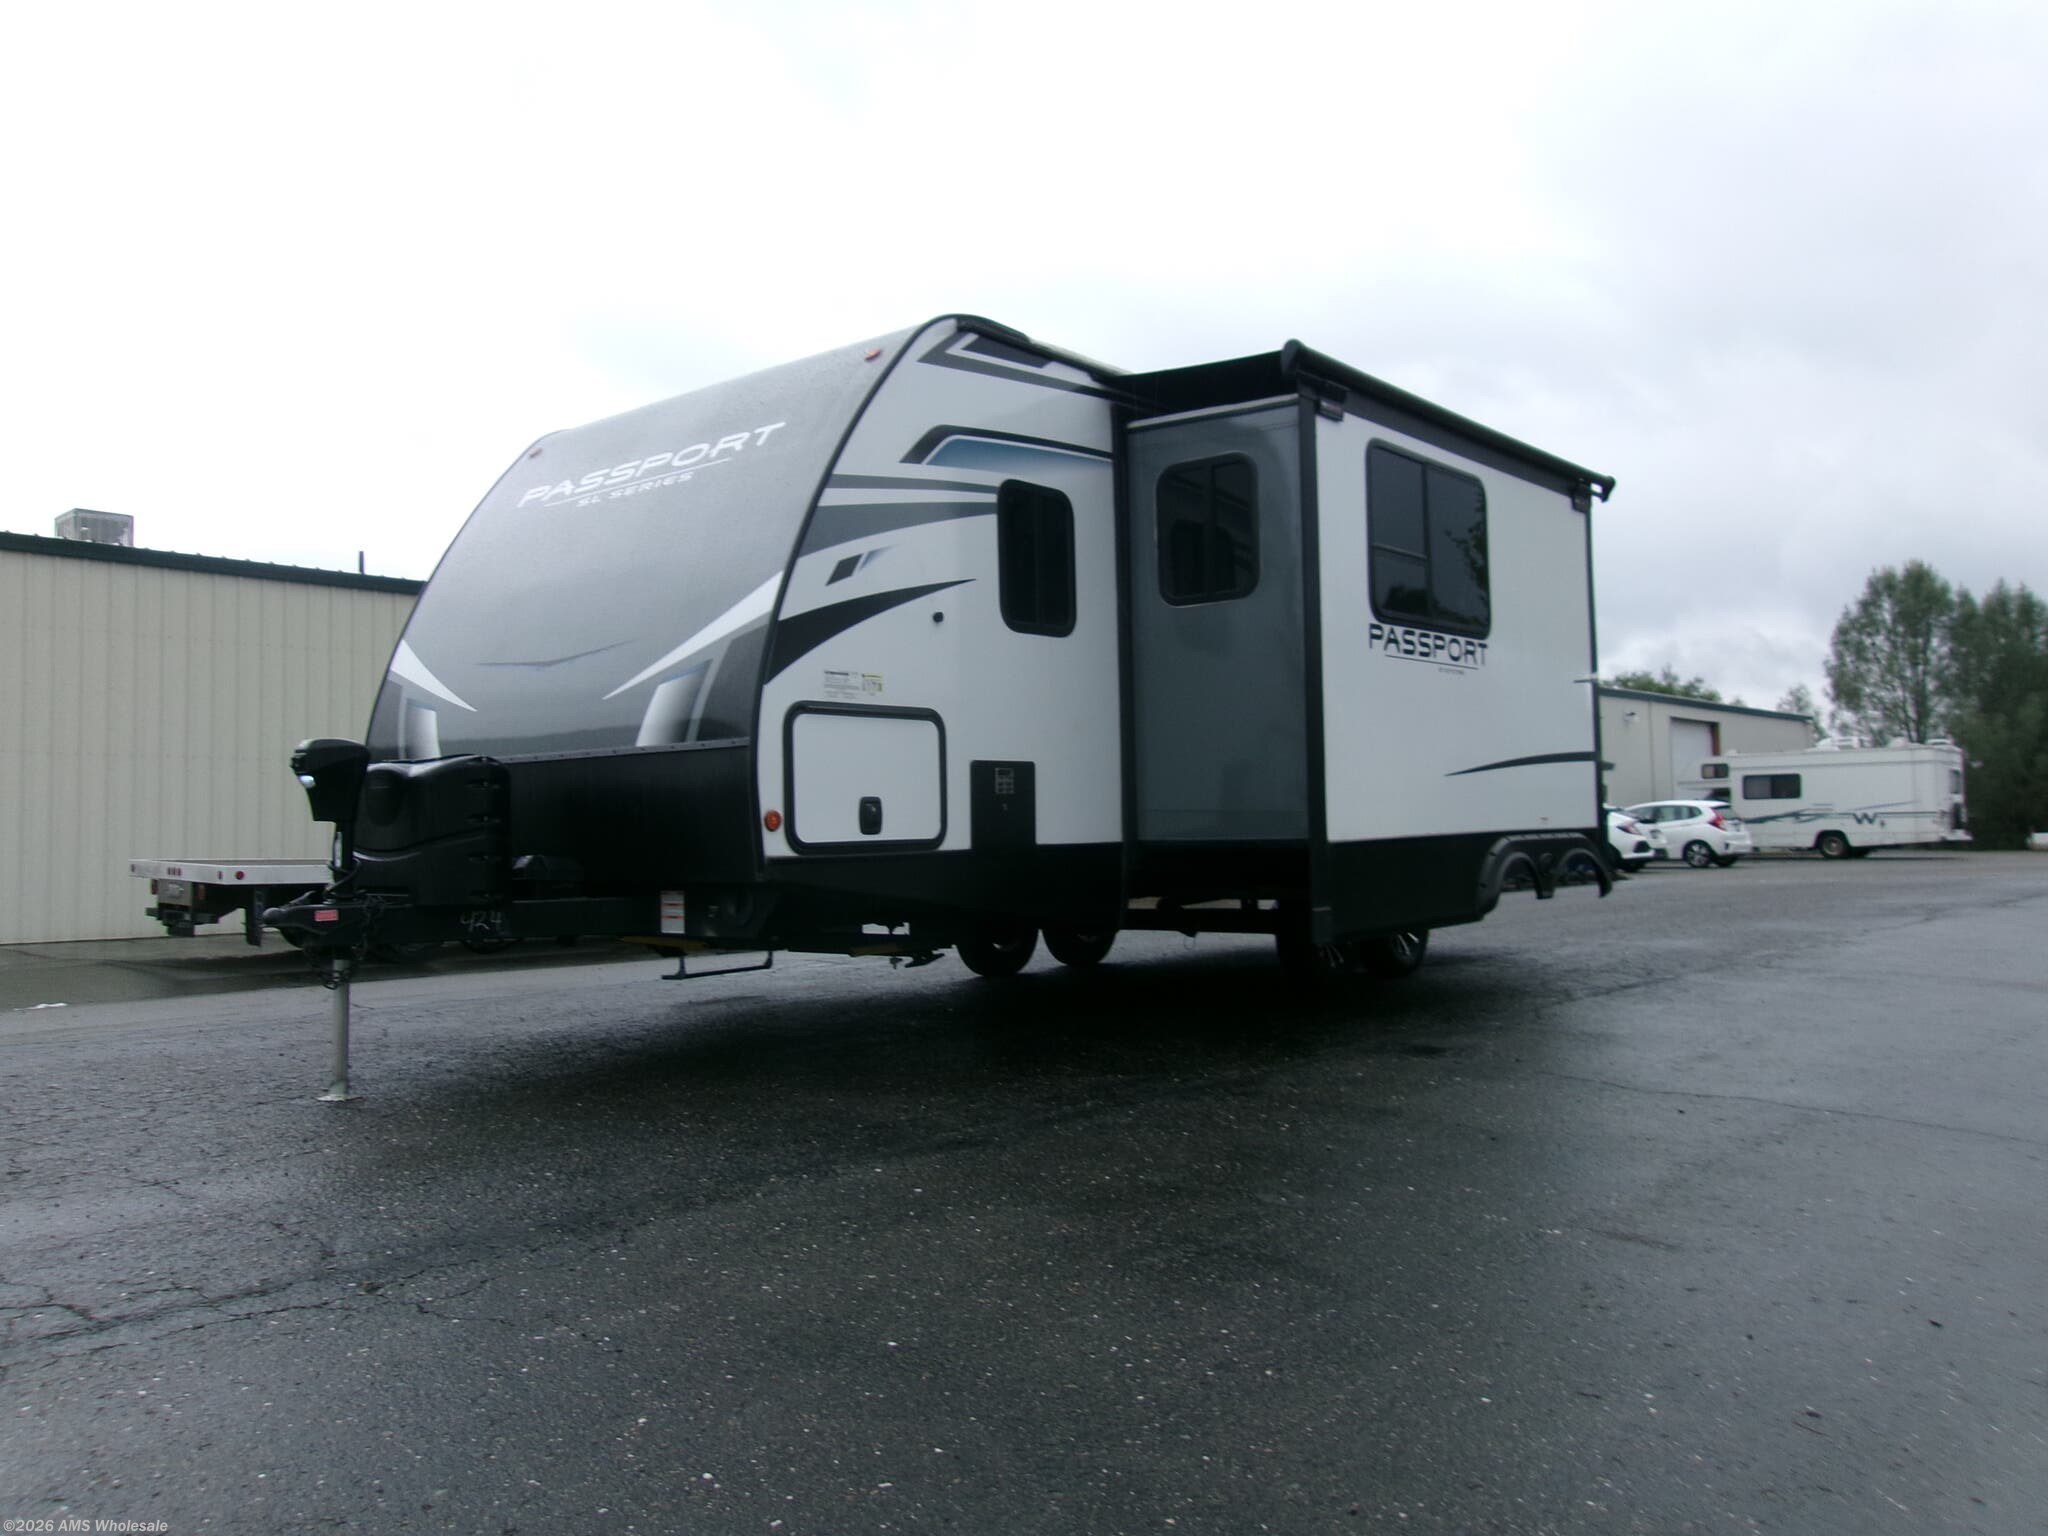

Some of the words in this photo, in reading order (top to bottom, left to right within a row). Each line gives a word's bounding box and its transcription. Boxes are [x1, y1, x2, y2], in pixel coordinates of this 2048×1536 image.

[517, 422, 786, 508] PASSPORT
[608, 471, 694, 499] SERIES
[1369, 623, 1488, 665] PASSPORT
